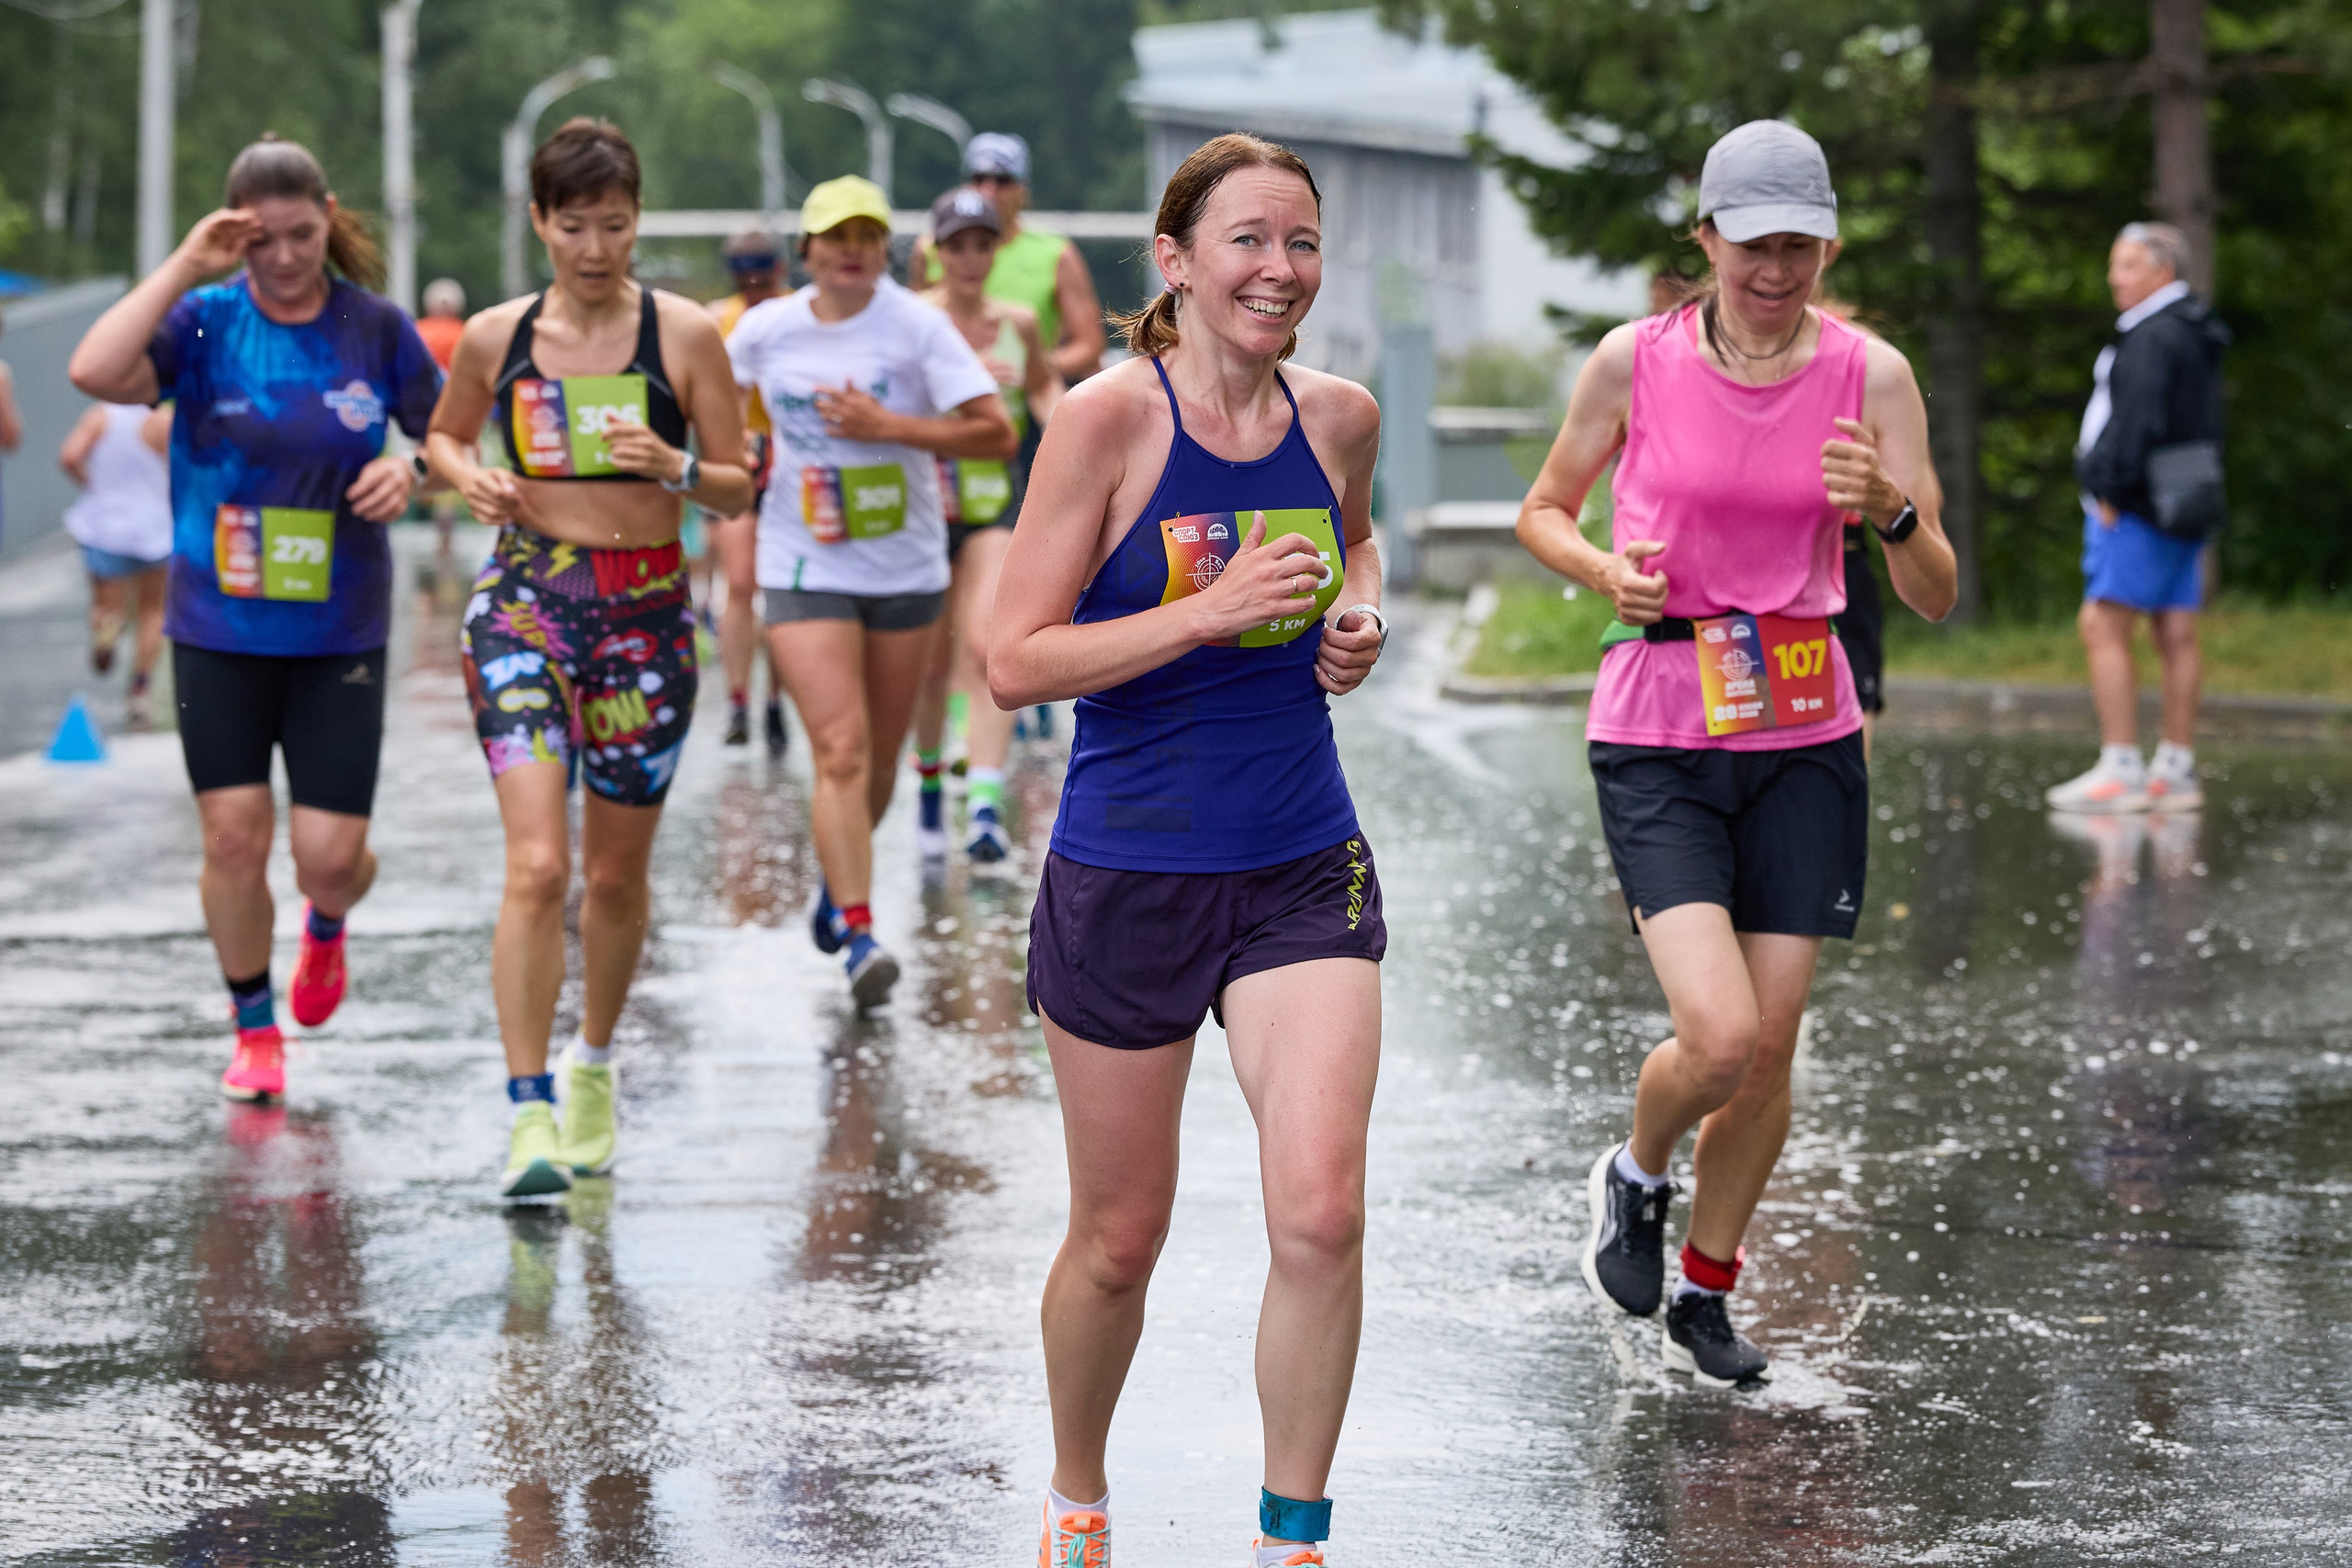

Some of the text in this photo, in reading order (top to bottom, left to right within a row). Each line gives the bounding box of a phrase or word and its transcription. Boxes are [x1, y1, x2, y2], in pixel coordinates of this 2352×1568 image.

[271, 534, 327, 565] 279
[1269, 619, 1281, 632] 5
[1772, 638, 1826, 680] 107
[1791, 698, 1806, 712] 10
